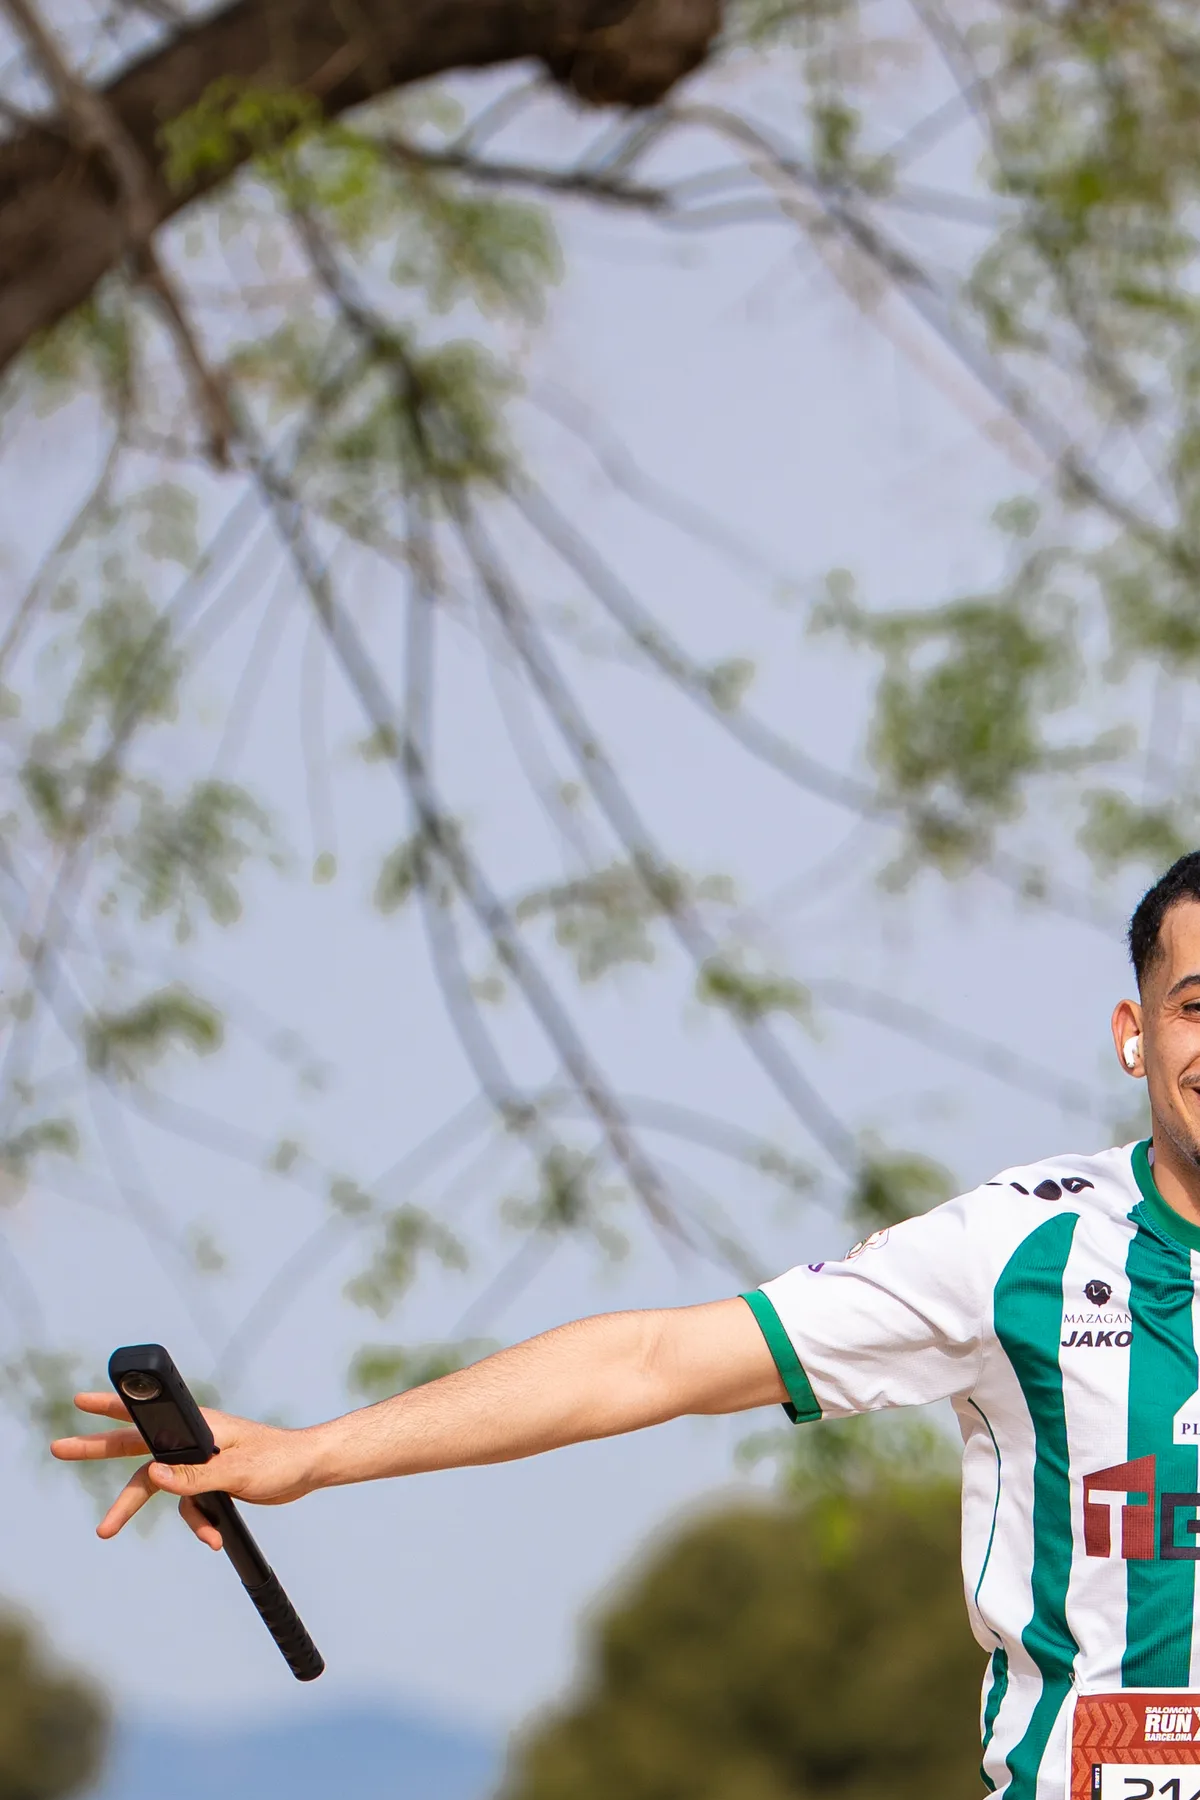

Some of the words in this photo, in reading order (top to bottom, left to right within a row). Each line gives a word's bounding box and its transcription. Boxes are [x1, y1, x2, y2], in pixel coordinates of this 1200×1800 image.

[1064, 1313, 1133, 1324] MAZAGAN
[1061, 1330, 1134, 1348] JAKO
[1145, 1706, 1192, 1714] SALOMON
[1144, 1713, 1193, 1733] RUN
[1144, 1732, 1193, 1742] BARCELONA
